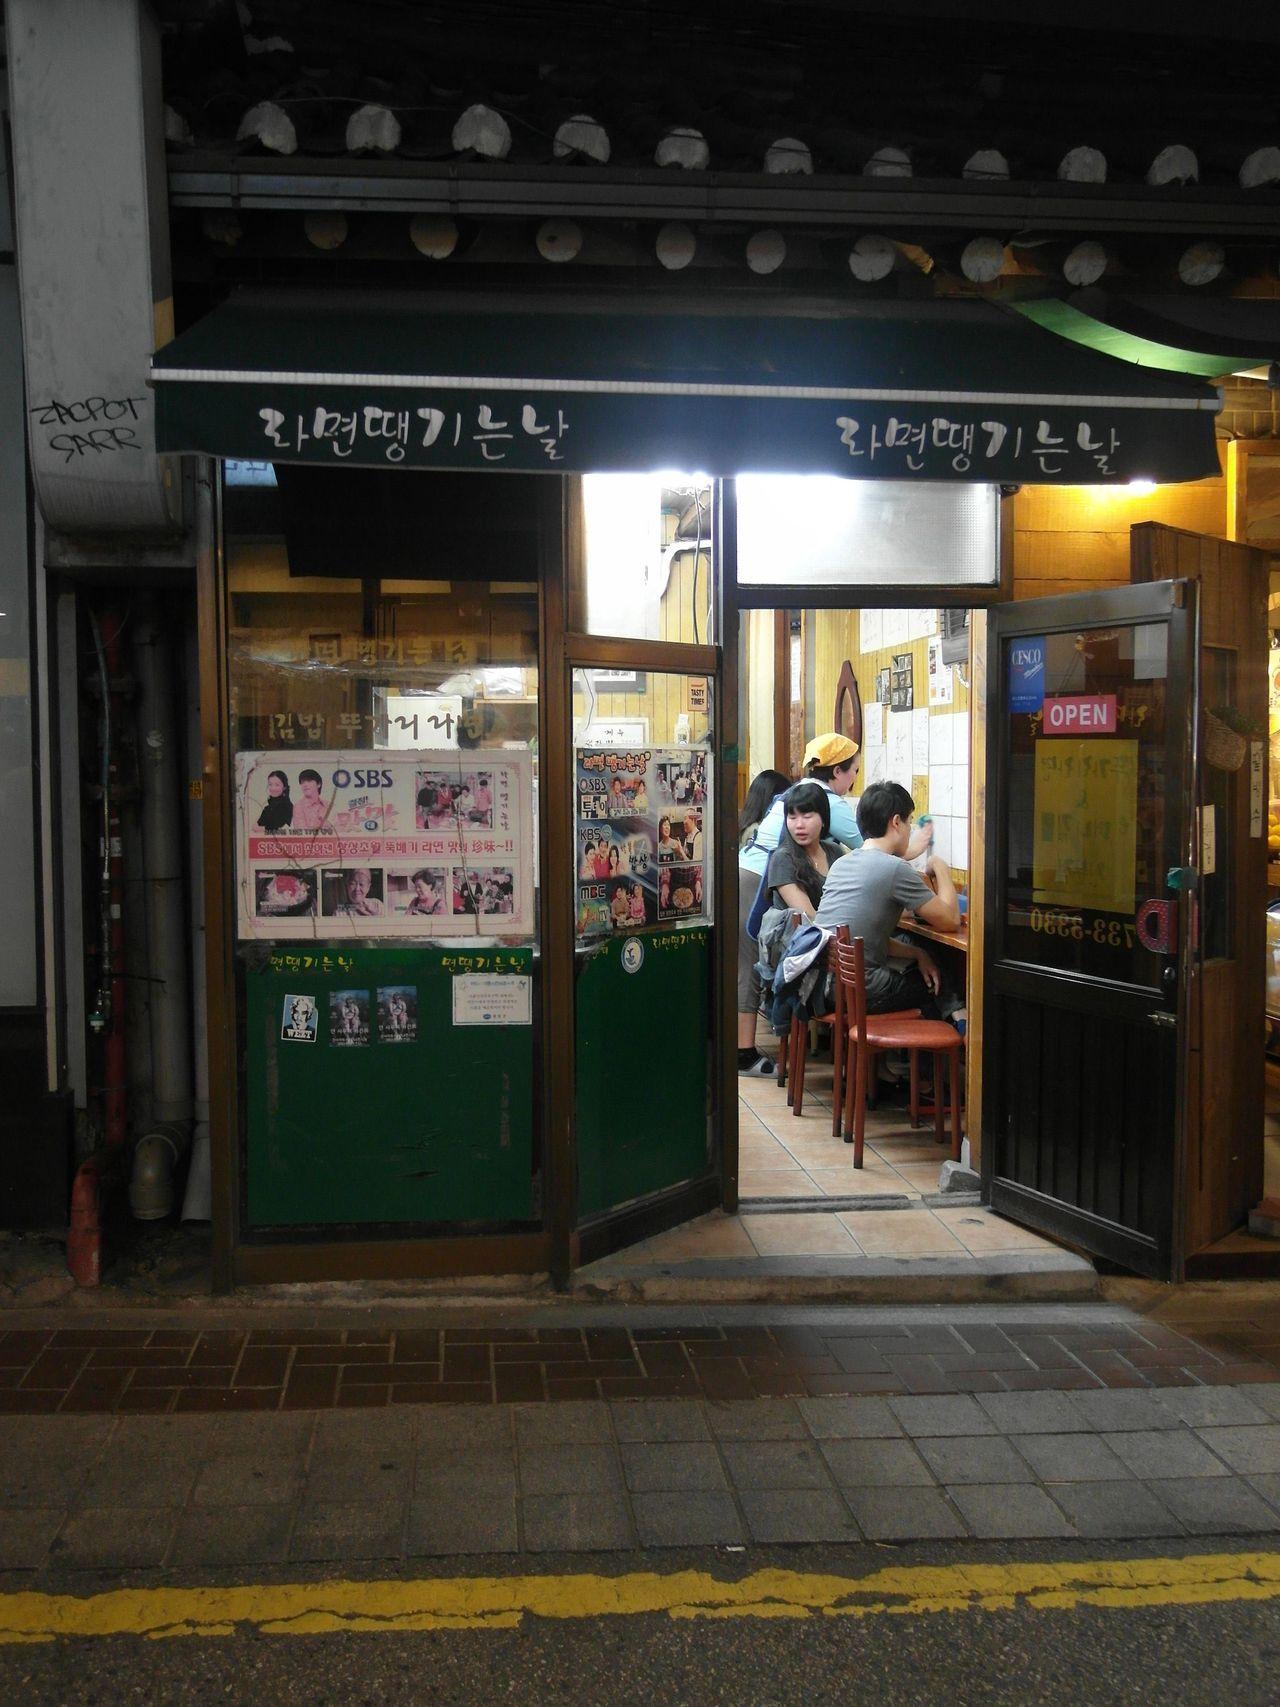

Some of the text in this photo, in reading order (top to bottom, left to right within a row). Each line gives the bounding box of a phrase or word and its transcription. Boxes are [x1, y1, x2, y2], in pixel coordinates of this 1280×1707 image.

[1012, 648, 1041, 665] CESCO
[691, 688, 704, 697] TASTY
[1050, 703, 1107, 727] OPEN
[354, 770, 393, 788] SBS
[589, 778, 607, 792] SBS
[580, 828, 601, 841] KBS
[384, 840, 419, 856] 뚝배기
[421, 840, 444, 856] 라면
[580, 885, 606, 901] MBC
